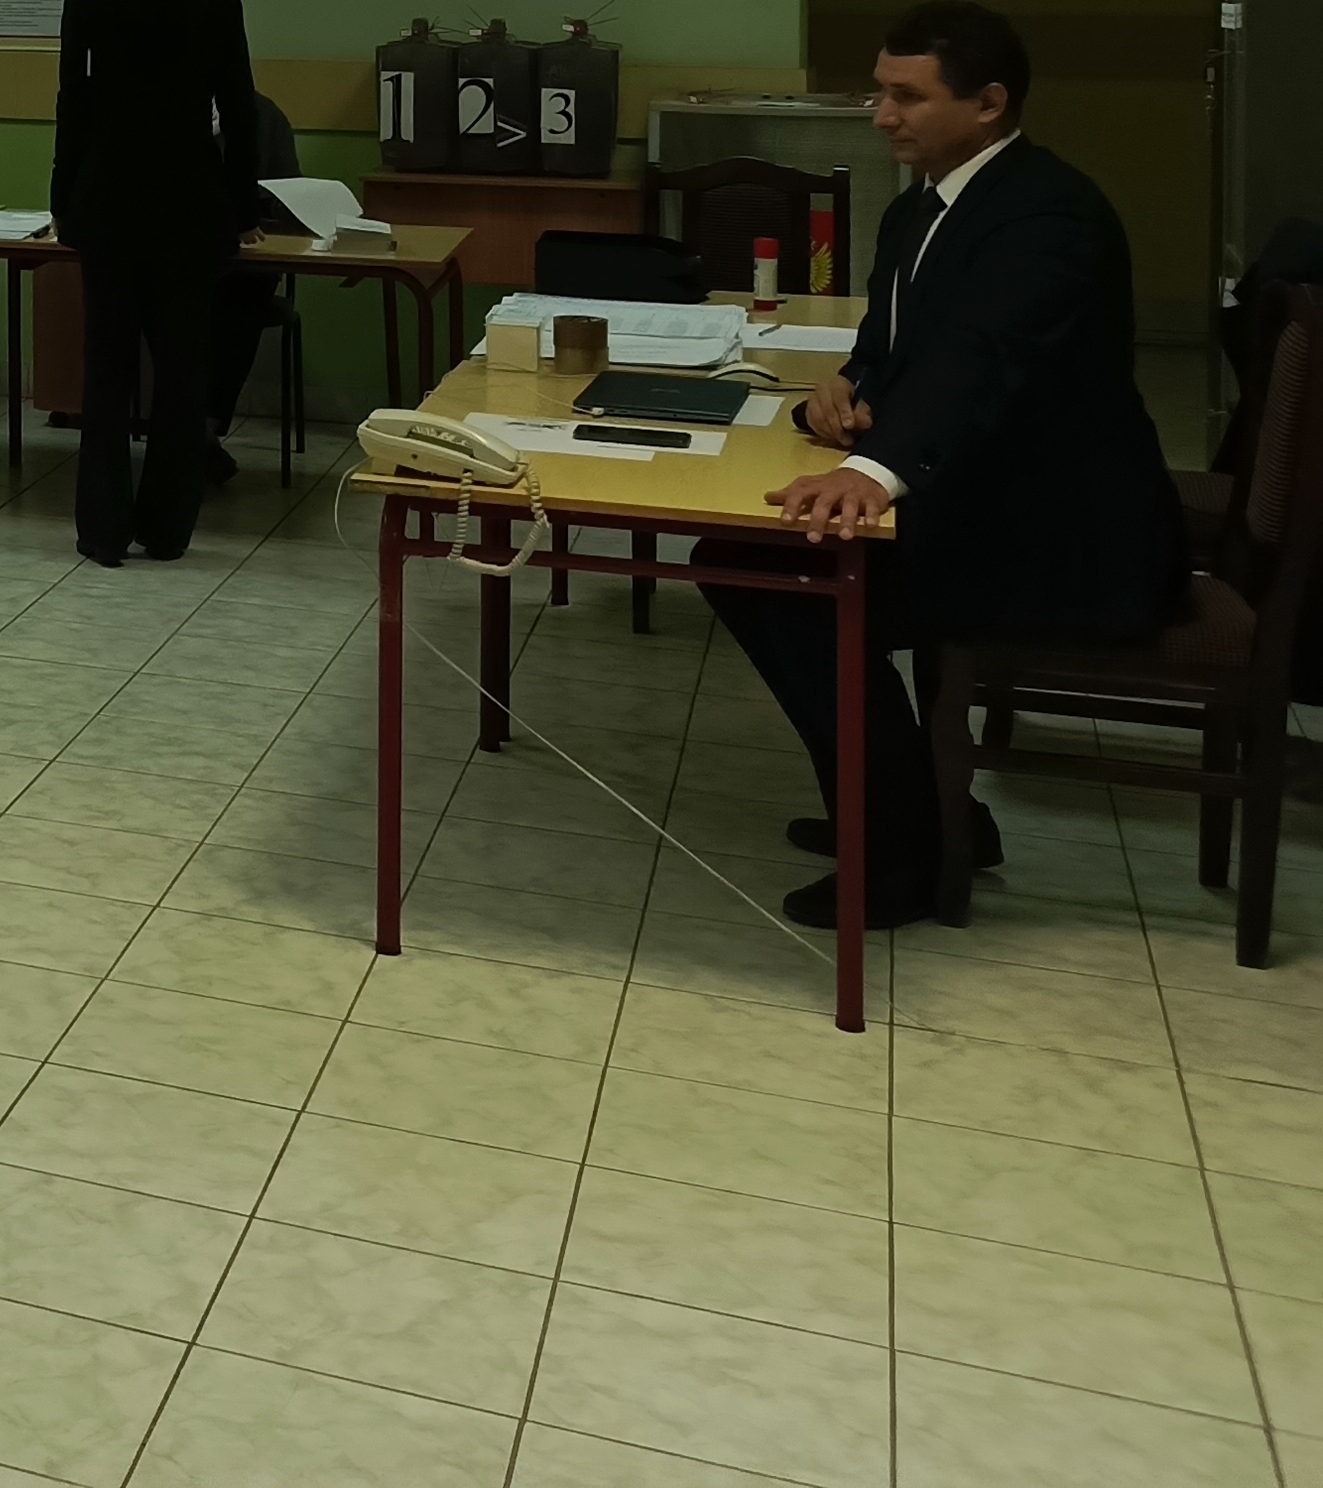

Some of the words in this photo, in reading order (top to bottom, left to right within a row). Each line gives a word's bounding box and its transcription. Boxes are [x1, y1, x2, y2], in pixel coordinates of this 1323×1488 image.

[381, 72, 414, 143] 1
[458, 77, 494, 135] 2
[547, 92, 573, 135] 3
